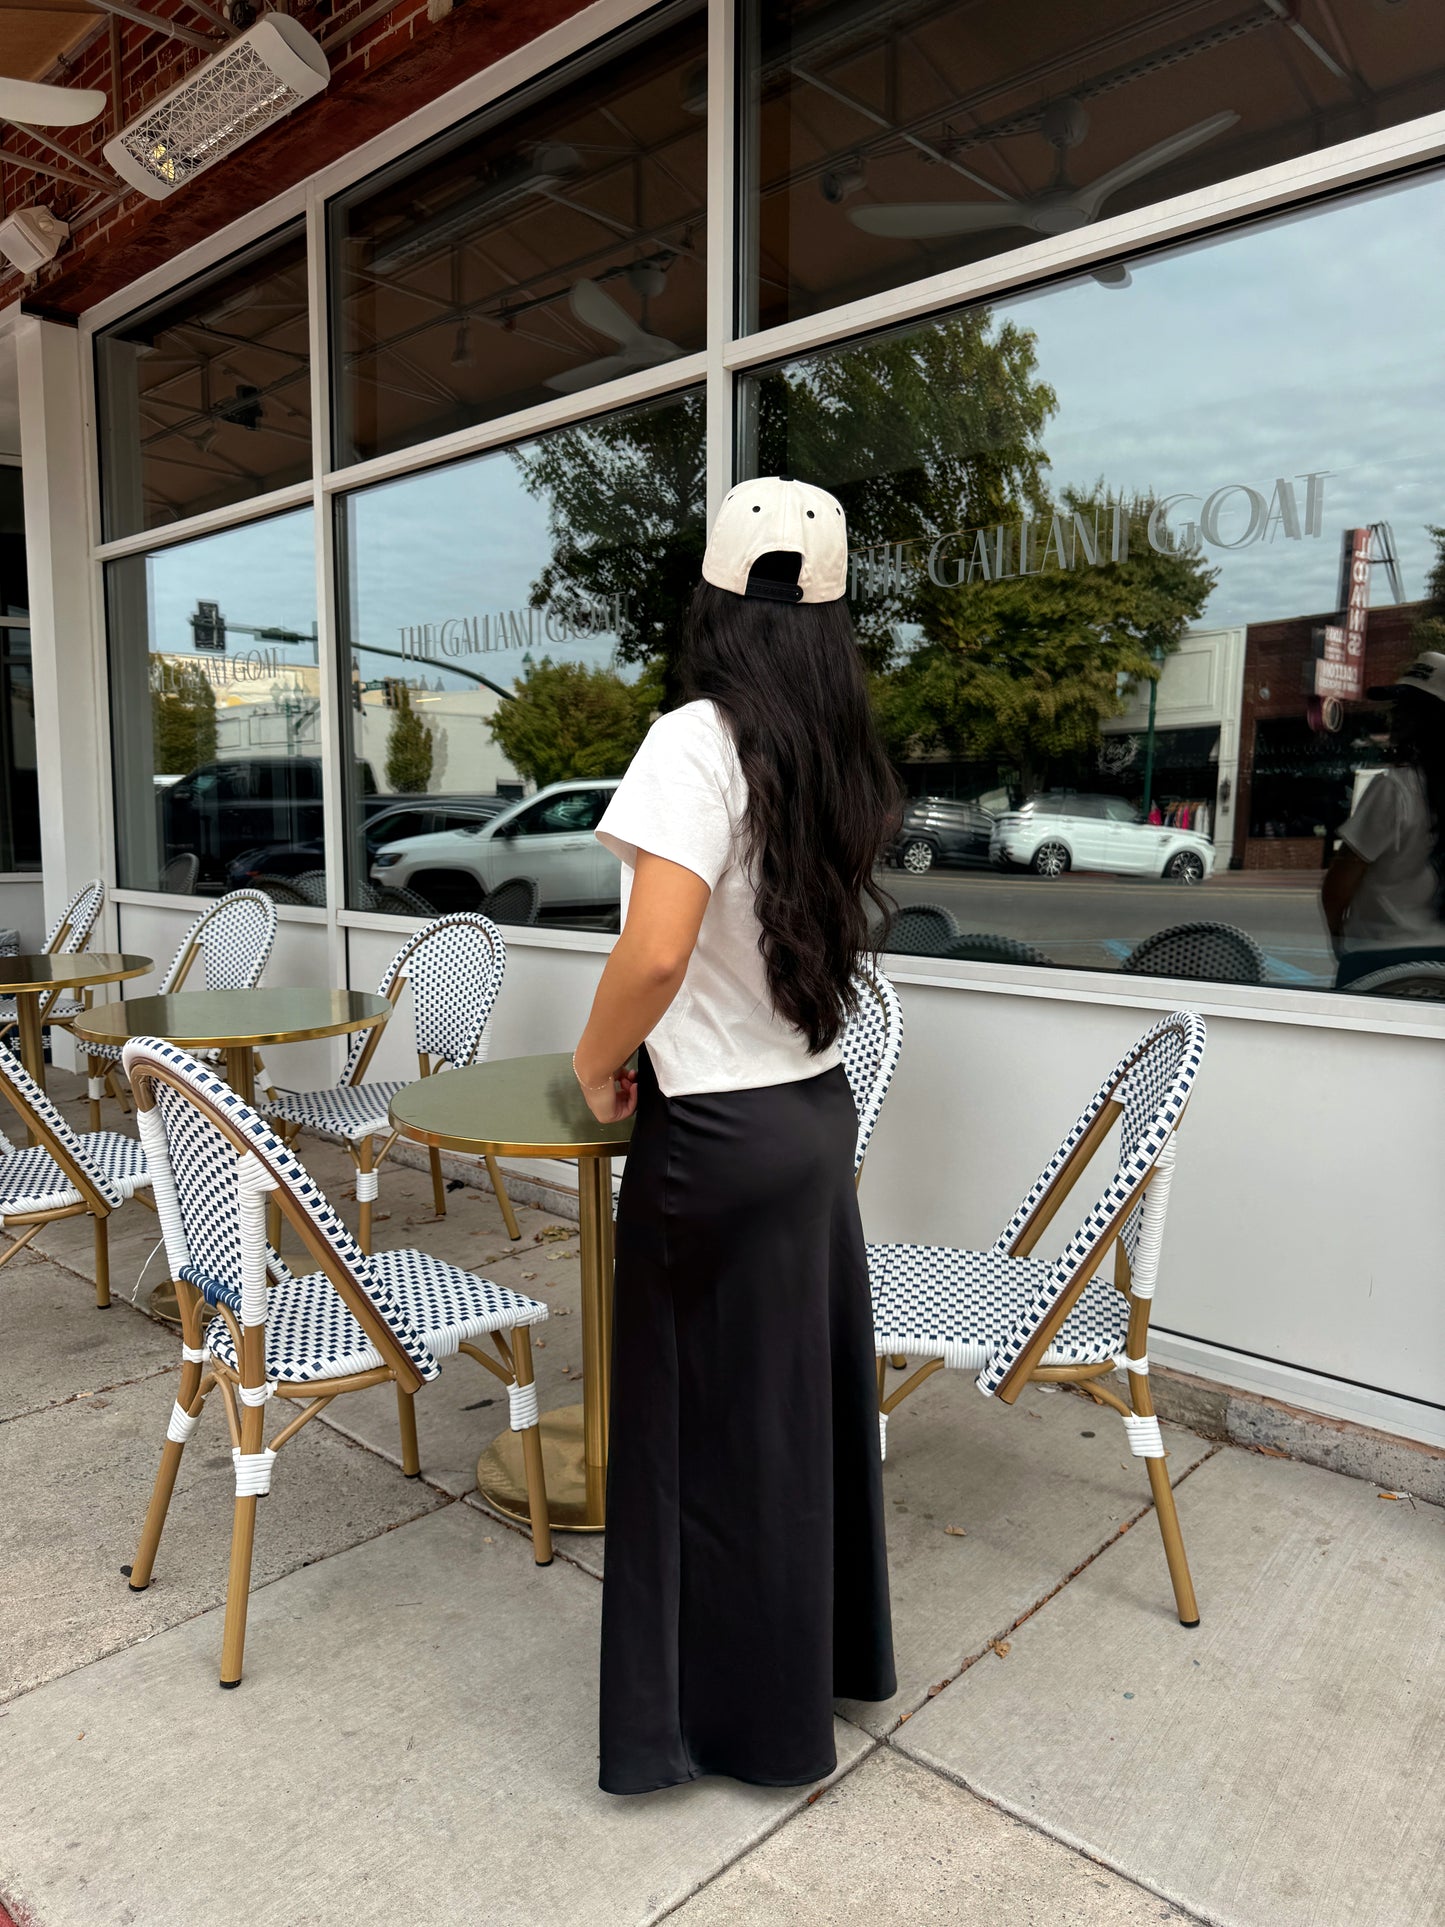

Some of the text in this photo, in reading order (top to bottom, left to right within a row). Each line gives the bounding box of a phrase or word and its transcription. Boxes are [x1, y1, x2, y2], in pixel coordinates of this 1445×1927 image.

[927, 504, 1125, 588] GALLANT
[1147, 471, 1332, 556] GOAT
[398, 591, 627, 662] THE GALLANT GOAT
[233, 646, 279, 683] GOAT
